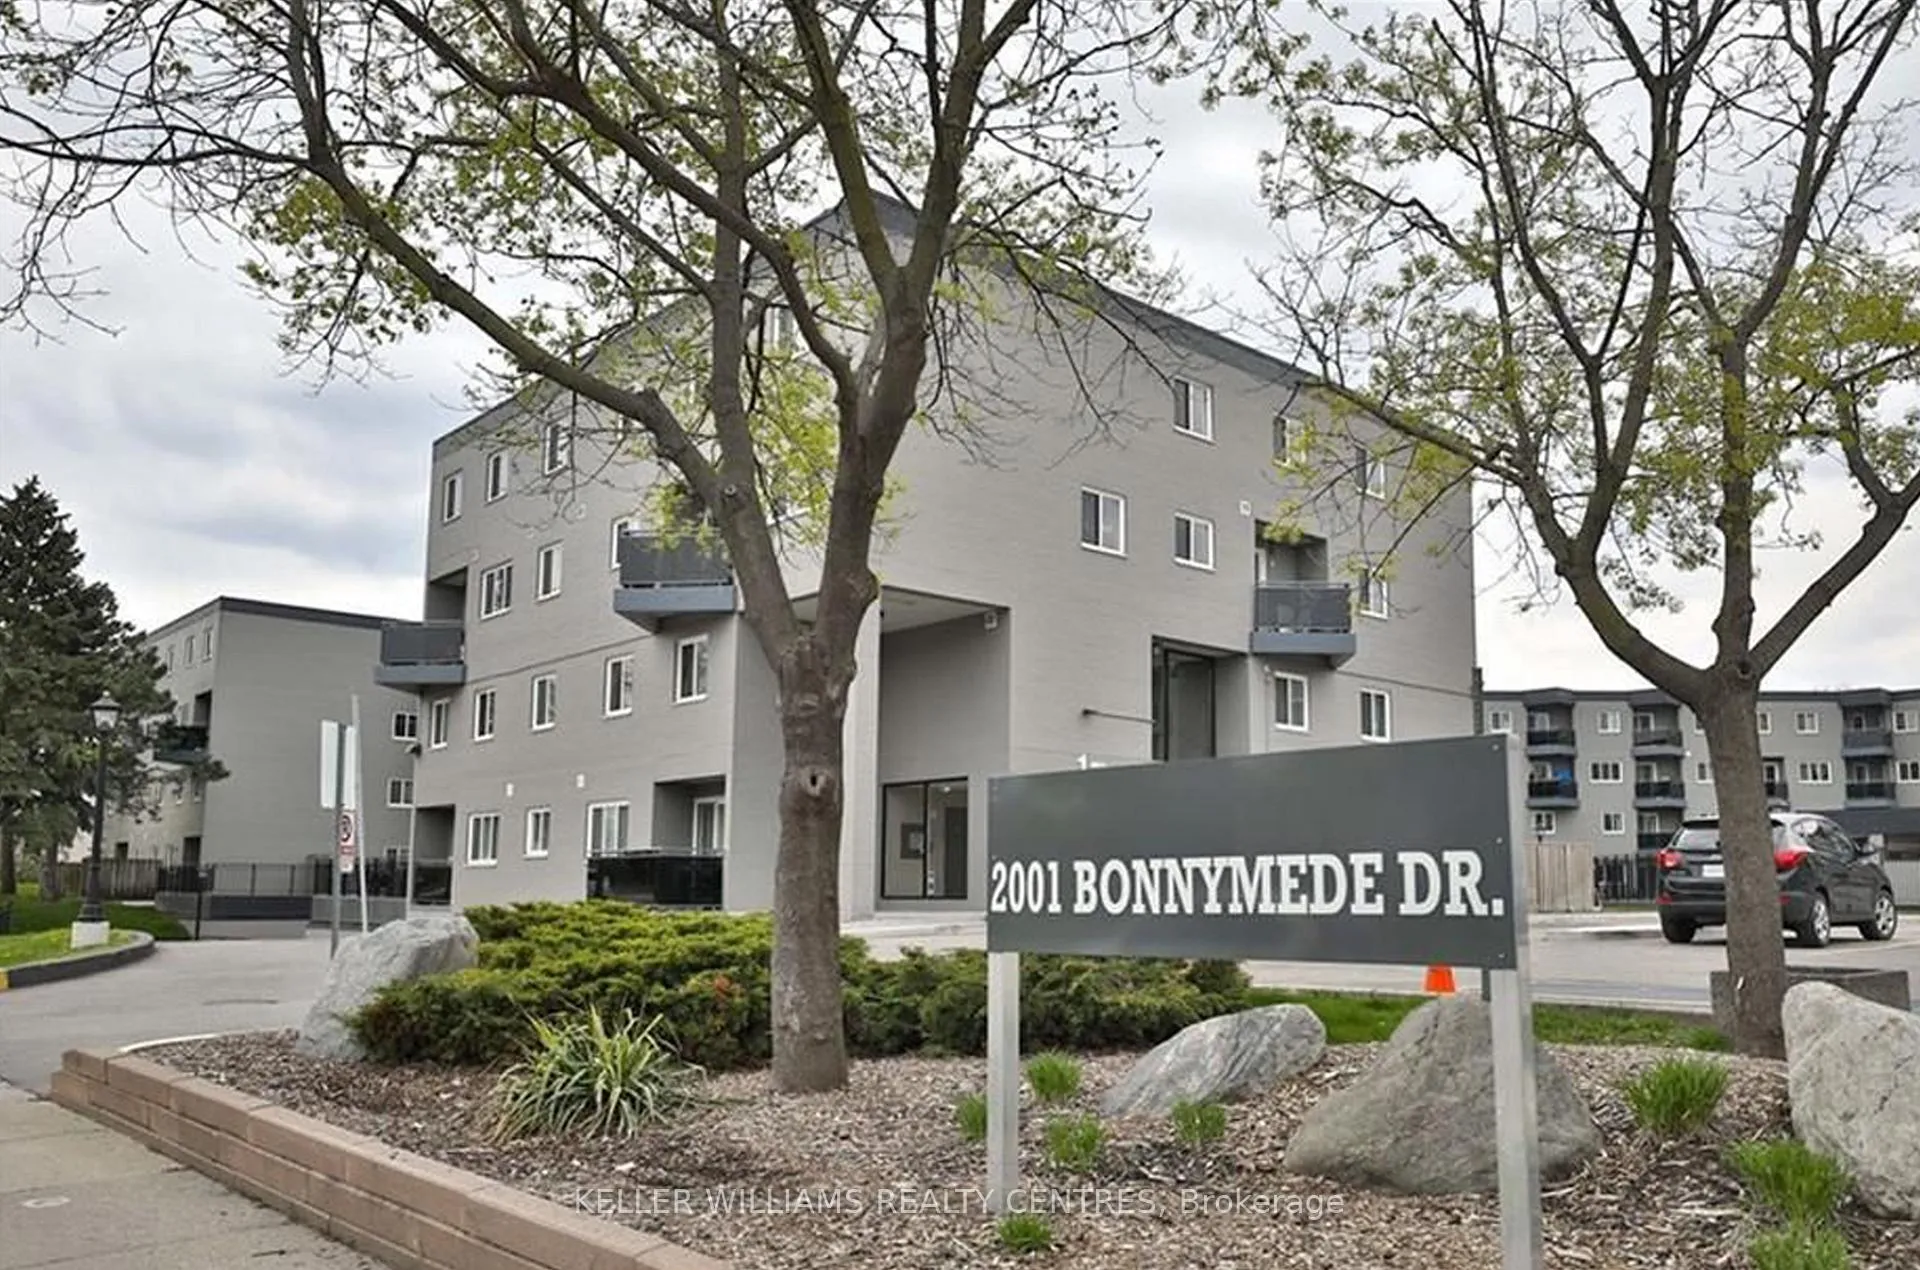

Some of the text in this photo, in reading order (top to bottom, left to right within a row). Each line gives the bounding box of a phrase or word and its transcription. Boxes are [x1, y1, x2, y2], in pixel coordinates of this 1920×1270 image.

[990, 850, 1505, 917] 2001 BONNYMEDE DR.
